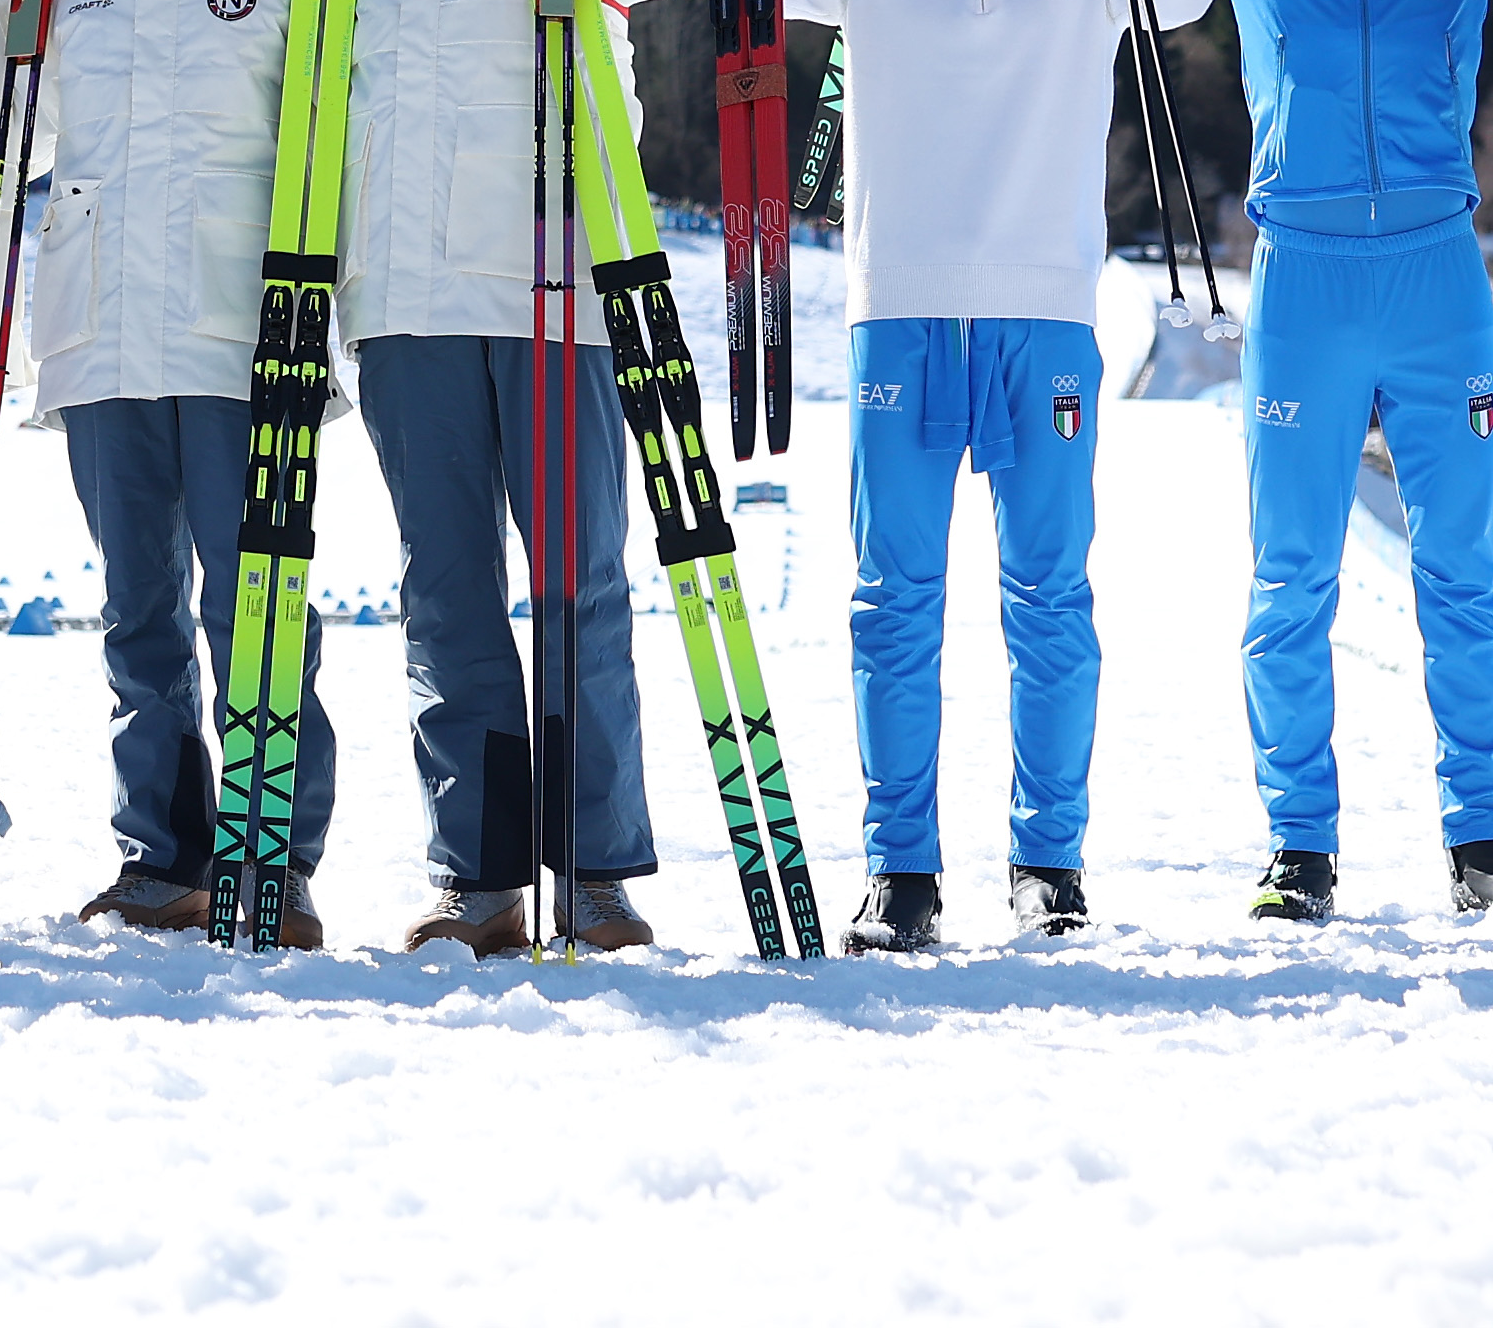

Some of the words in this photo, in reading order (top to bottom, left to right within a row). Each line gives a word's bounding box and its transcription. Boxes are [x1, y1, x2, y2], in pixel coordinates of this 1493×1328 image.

[69, 0, 103, 15] CRAFT
[802, 118, 832, 188] SPEED
[727, 277, 740, 352] PREMIUM
[763, 276, 774, 346] PREMIUM
[857, 382, 903, 406] EA7
[1054, 398, 1079, 406] ITALIA
[1255, 395, 1301, 422] EA7
[1470, 396, 1493, 407] ITALIA
[214, 874, 238, 948] SPEED
[257, 878, 281, 951] SPEED
[748, 884, 783, 962] SPEED
[788, 880, 824, 959] SPEED
